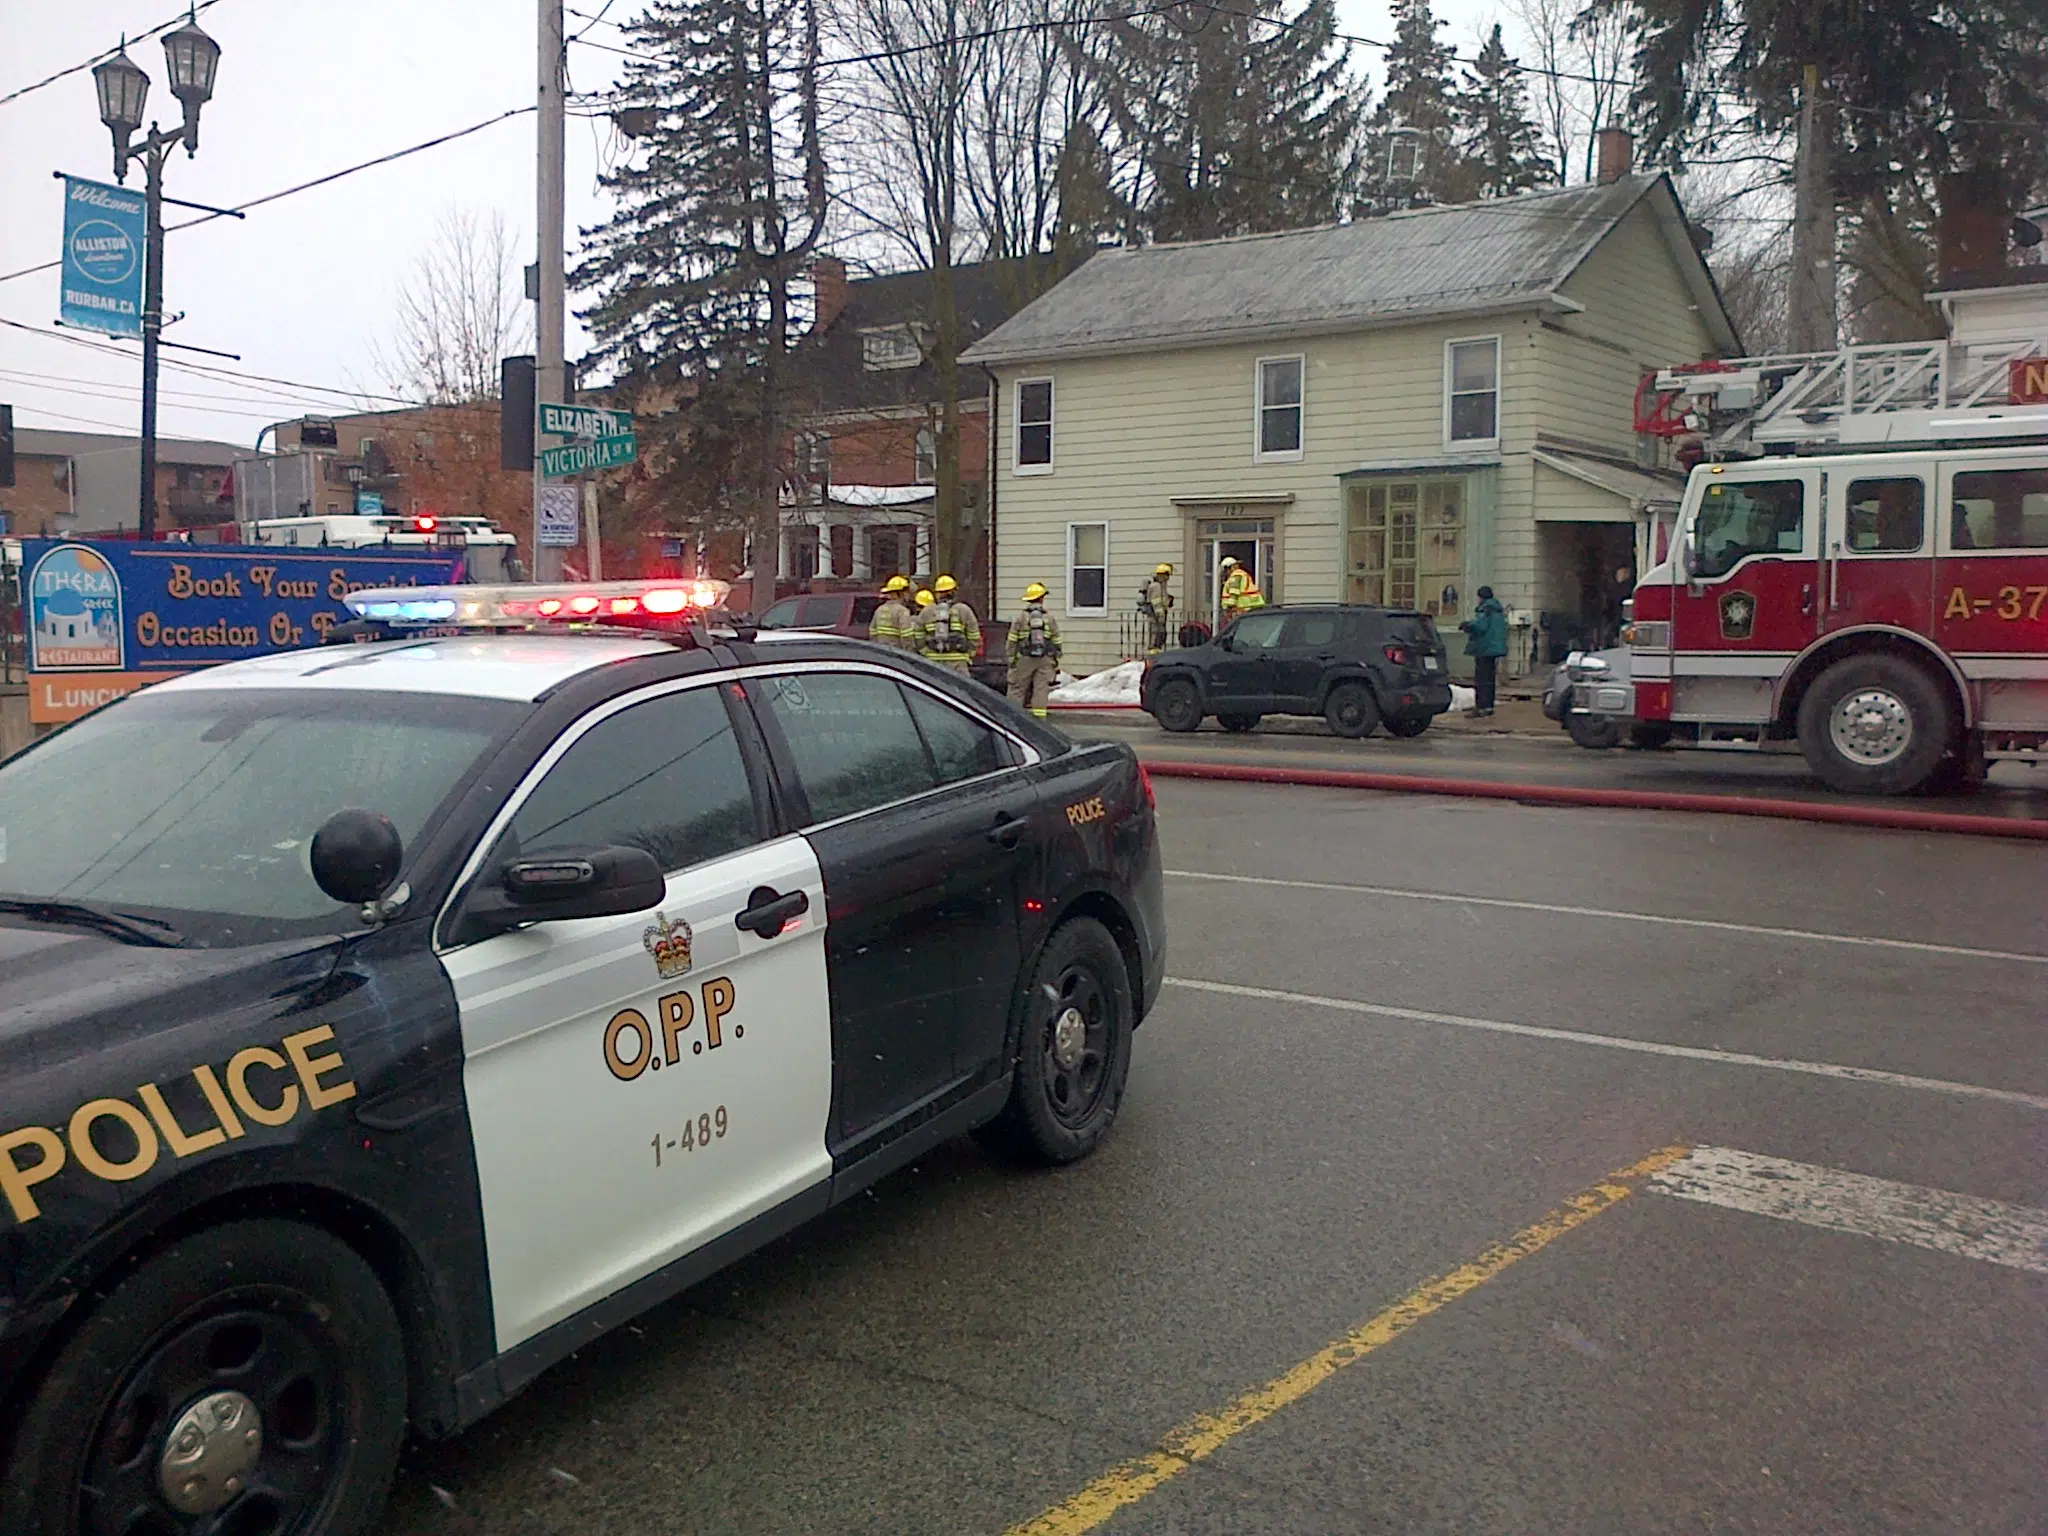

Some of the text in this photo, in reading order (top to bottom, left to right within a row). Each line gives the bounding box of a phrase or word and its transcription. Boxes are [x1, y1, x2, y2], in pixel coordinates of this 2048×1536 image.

[70, 185, 140, 214] Welcome
[75, 237, 128, 252] ALLISTON
[65, 290, 136, 315] RURBAN.CA
[545, 408, 618, 437] ELIZABETH
[545, 442, 611, 473] VICTORIA
[613, 443, 621, 457] ST
[40, 570, 113, 593] THERA
[168, 561, 242, 599] Book
[251, 565, 317, 599] Your
[137, 611, 259, 647] Occasion
[270, 611, 303, 645] Or
[39, 649, 118, 664] RESTAURANT
[1065, 796, 1106, 827] POLICE
[603, 976, 744, 1082] O.P.P.
[0, 1024, 357, 1224] POLICE
[651, 1105, 728, 1168] 1-489
